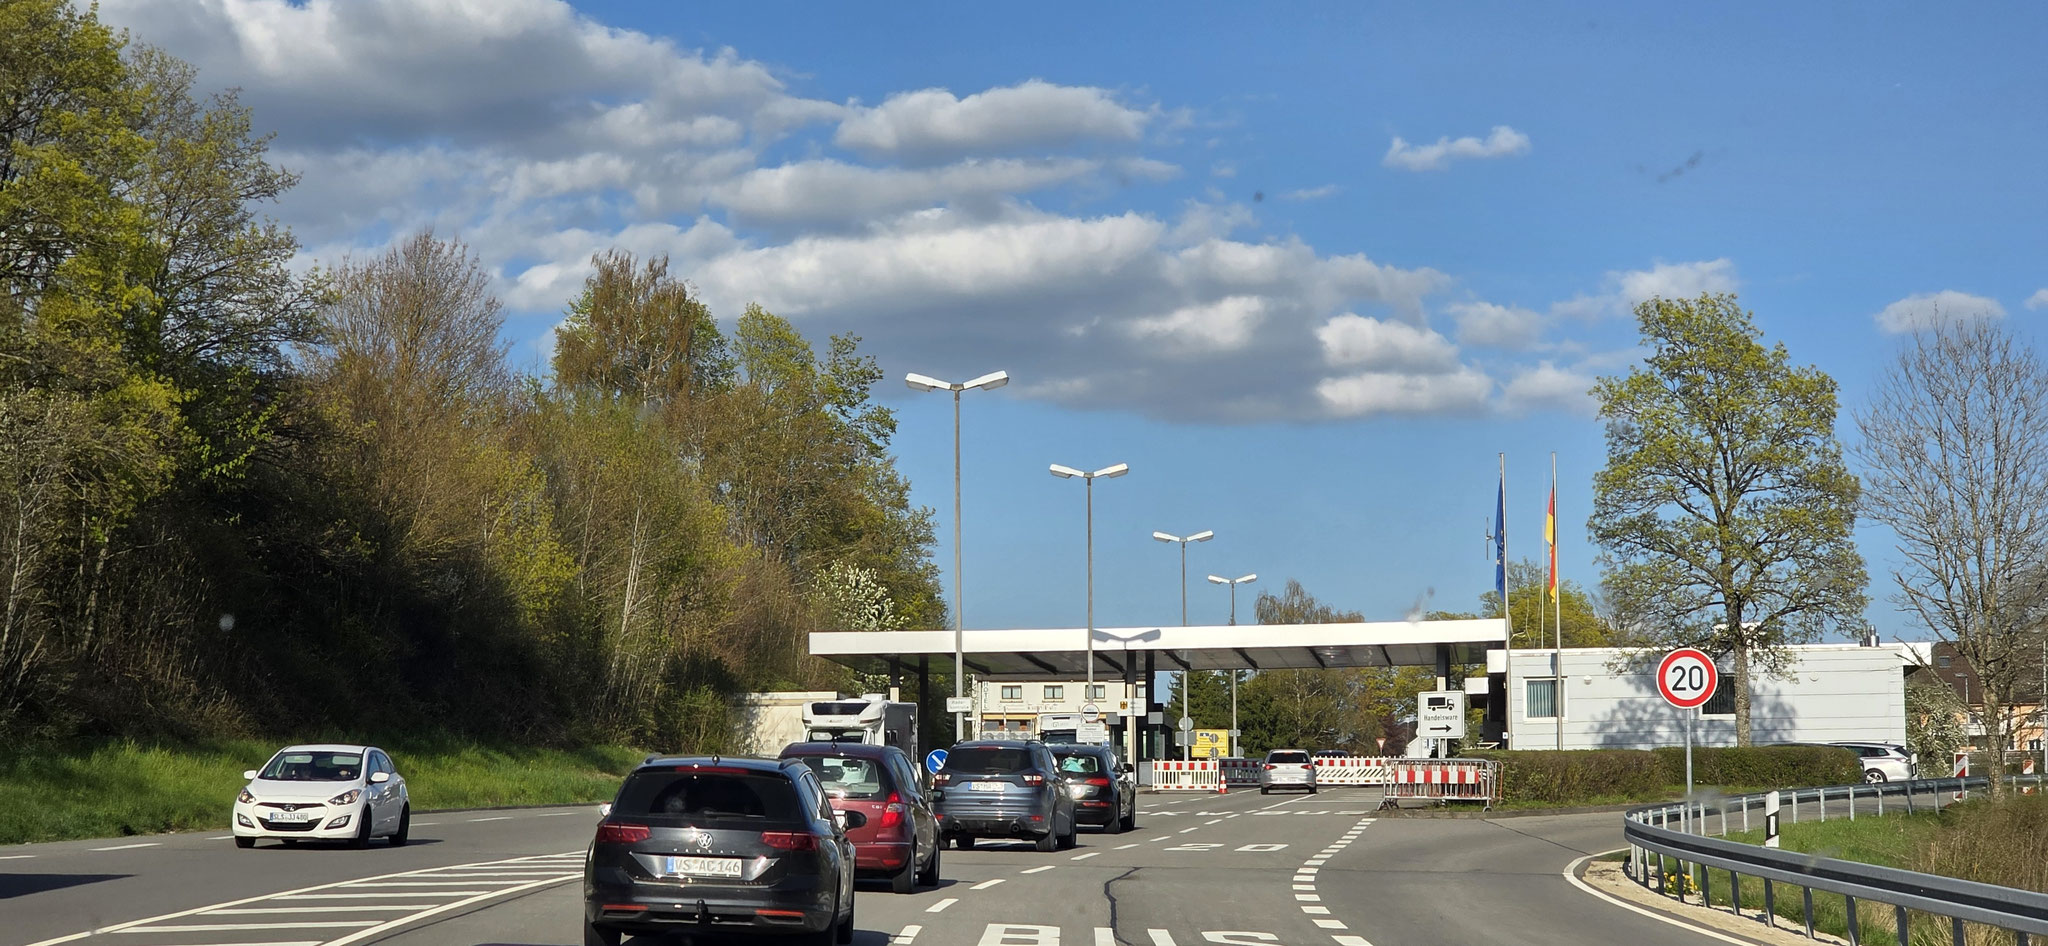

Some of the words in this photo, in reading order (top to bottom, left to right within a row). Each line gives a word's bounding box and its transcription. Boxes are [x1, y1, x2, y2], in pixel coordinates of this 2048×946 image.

[1672, 665, 1703, 691] 20
[1163, 843, 1289, 852] 20
[675, 860, 691, 871] VS
[699, 860, 715, 872] AC
[717, 861, 740, 873] 146
